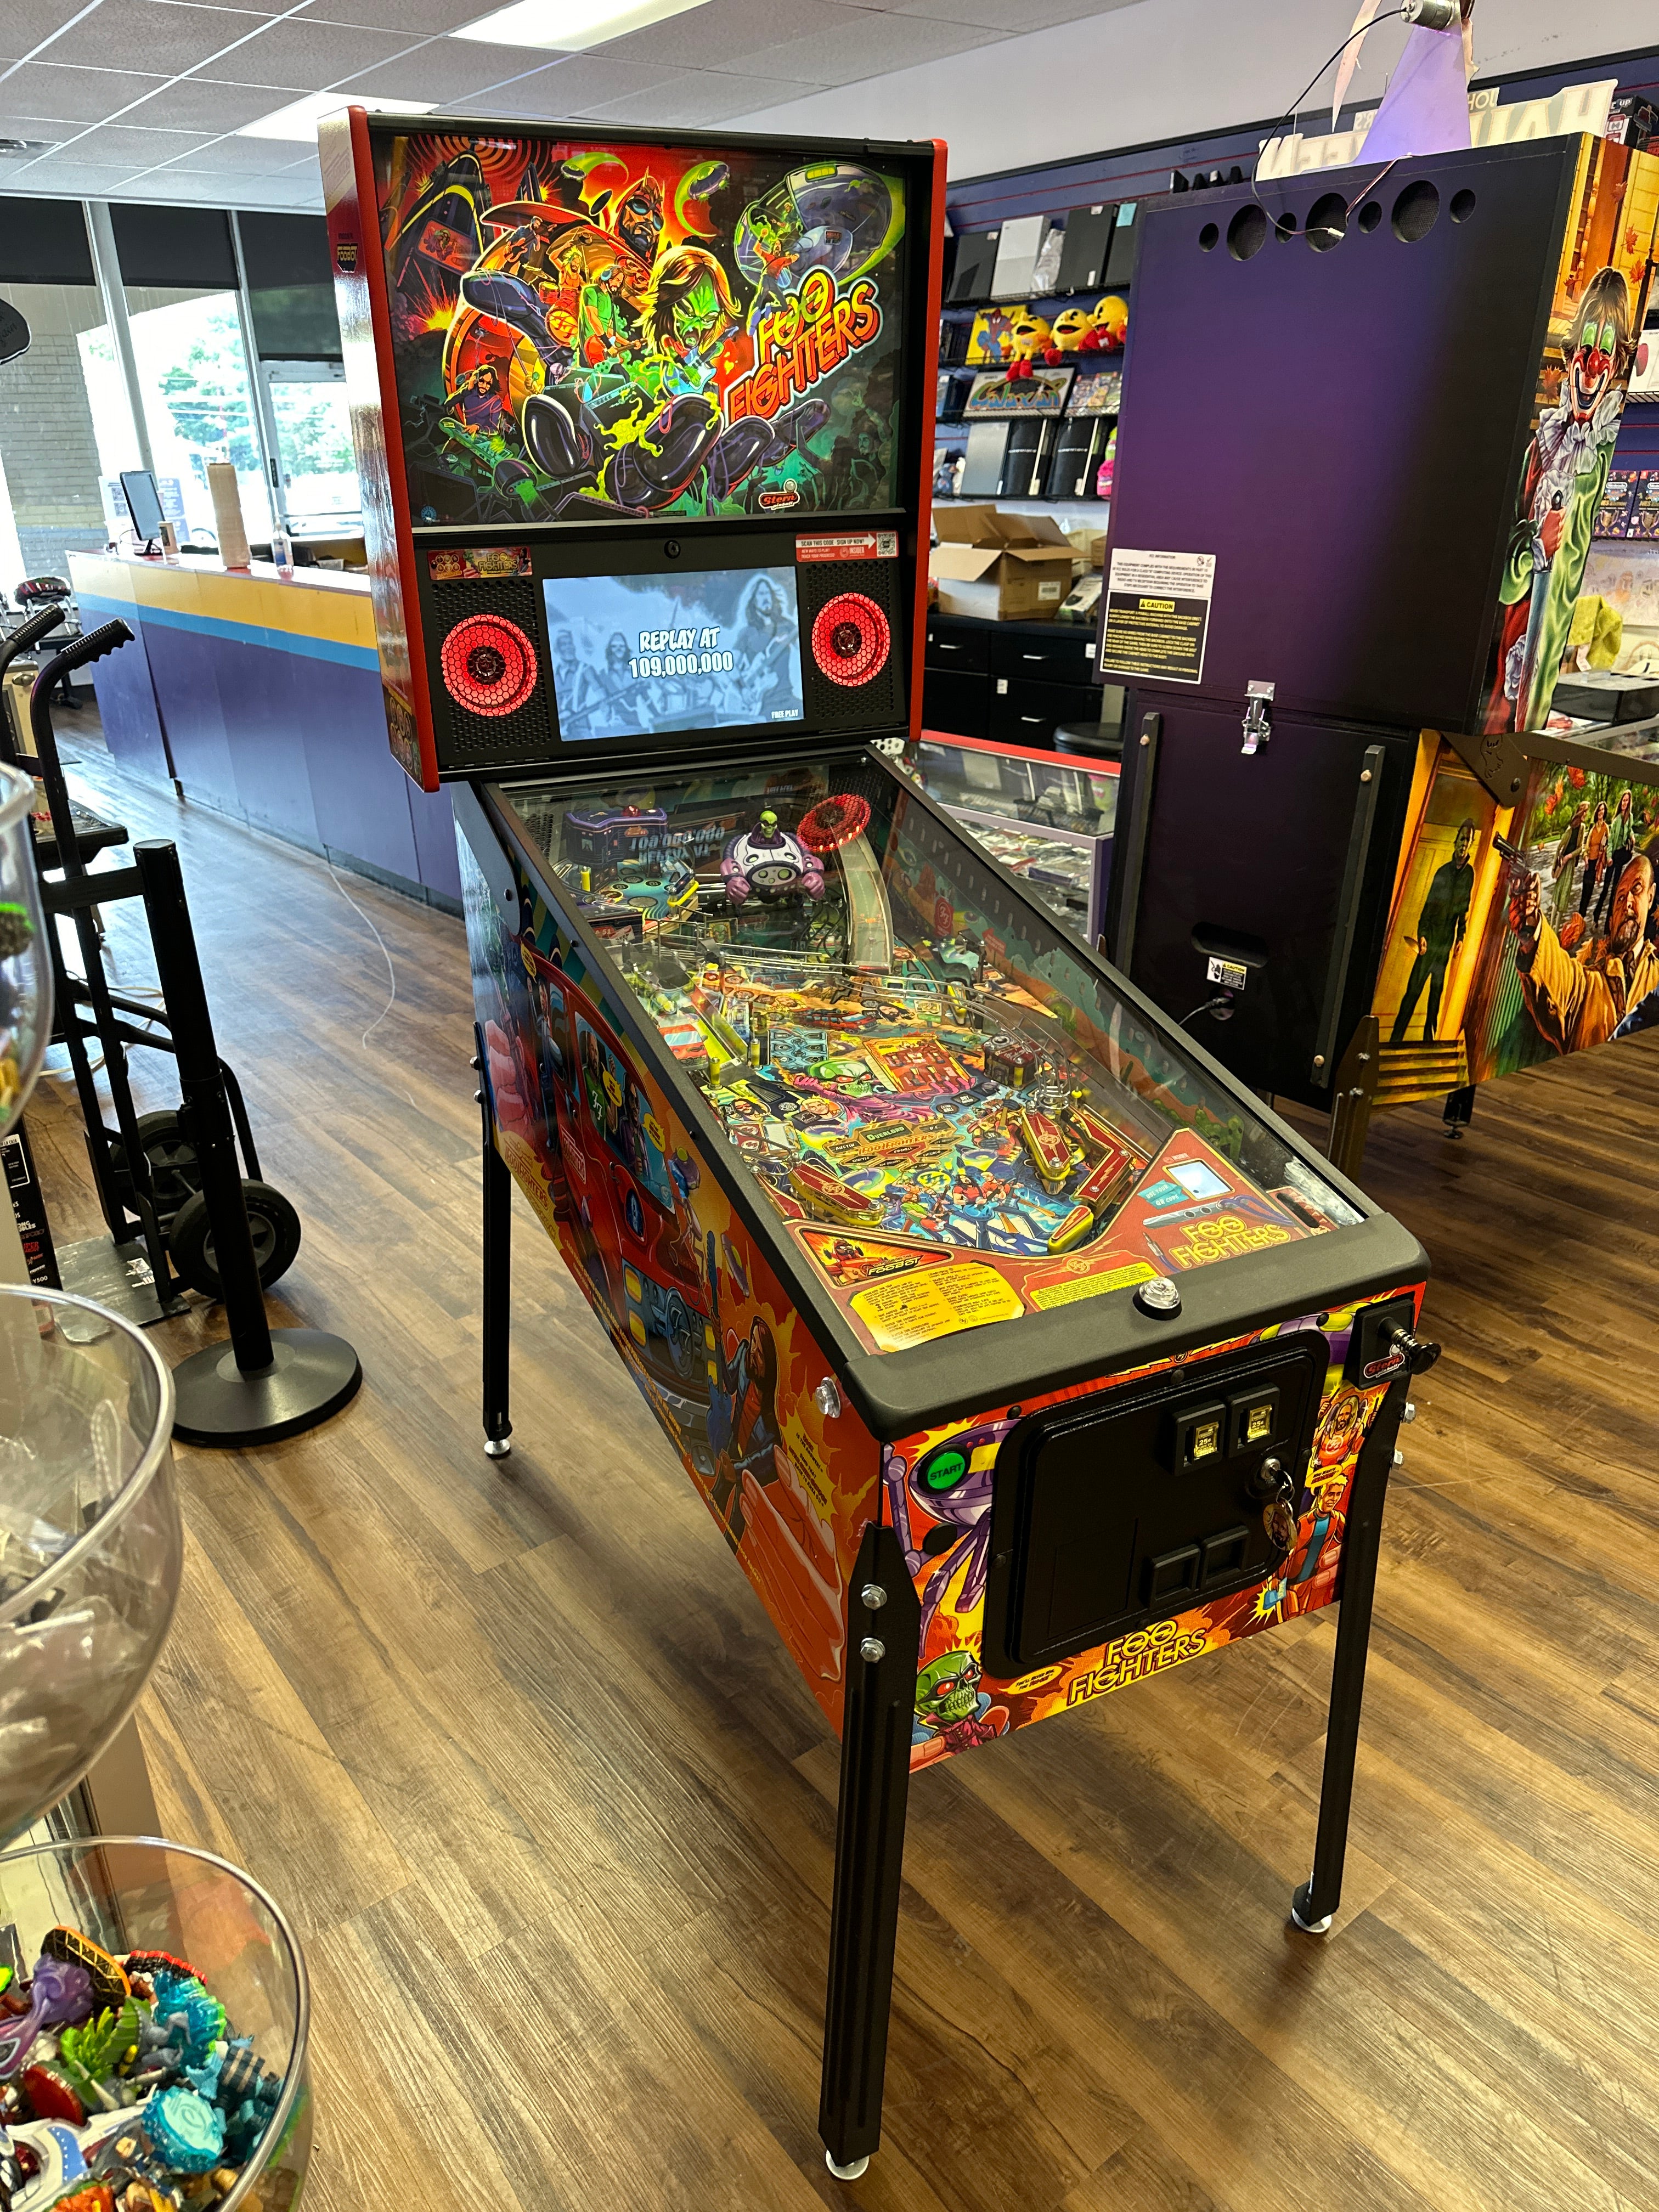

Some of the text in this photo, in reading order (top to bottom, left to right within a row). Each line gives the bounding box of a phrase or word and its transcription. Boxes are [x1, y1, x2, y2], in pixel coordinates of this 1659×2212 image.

[758, 272, 835, 365] FOO
[730, 283, 878, 424] FIGHTERS
[762, 494, 797, 506] Stern
[478, 560, 518, 571] FIGHTERS
[486, 552, 508, 562] FOO
[1146, 601, 1173, 610] CAUTION
[639, 626, 720, 653] REPLAY AT
[628, 651, 734, 679] 109,000,000
[771, 709, 799, 719] FREE PLAY
[834, 1142, 855, 1152] AUSTIN
[1181, 1215, 1246, 1244] FOO
[1170, 1224, 1290, 1268] FIGHTERS
[868, 1256, 921, 1276] FOOBOT
[1368, 1356, 1401, 1373] Stern
[930, 1462, 963, 1481] START
[1105, 1619, 1177, 1667] FOO
[1068, 1628, 1206, 1706] FIGHTERS
